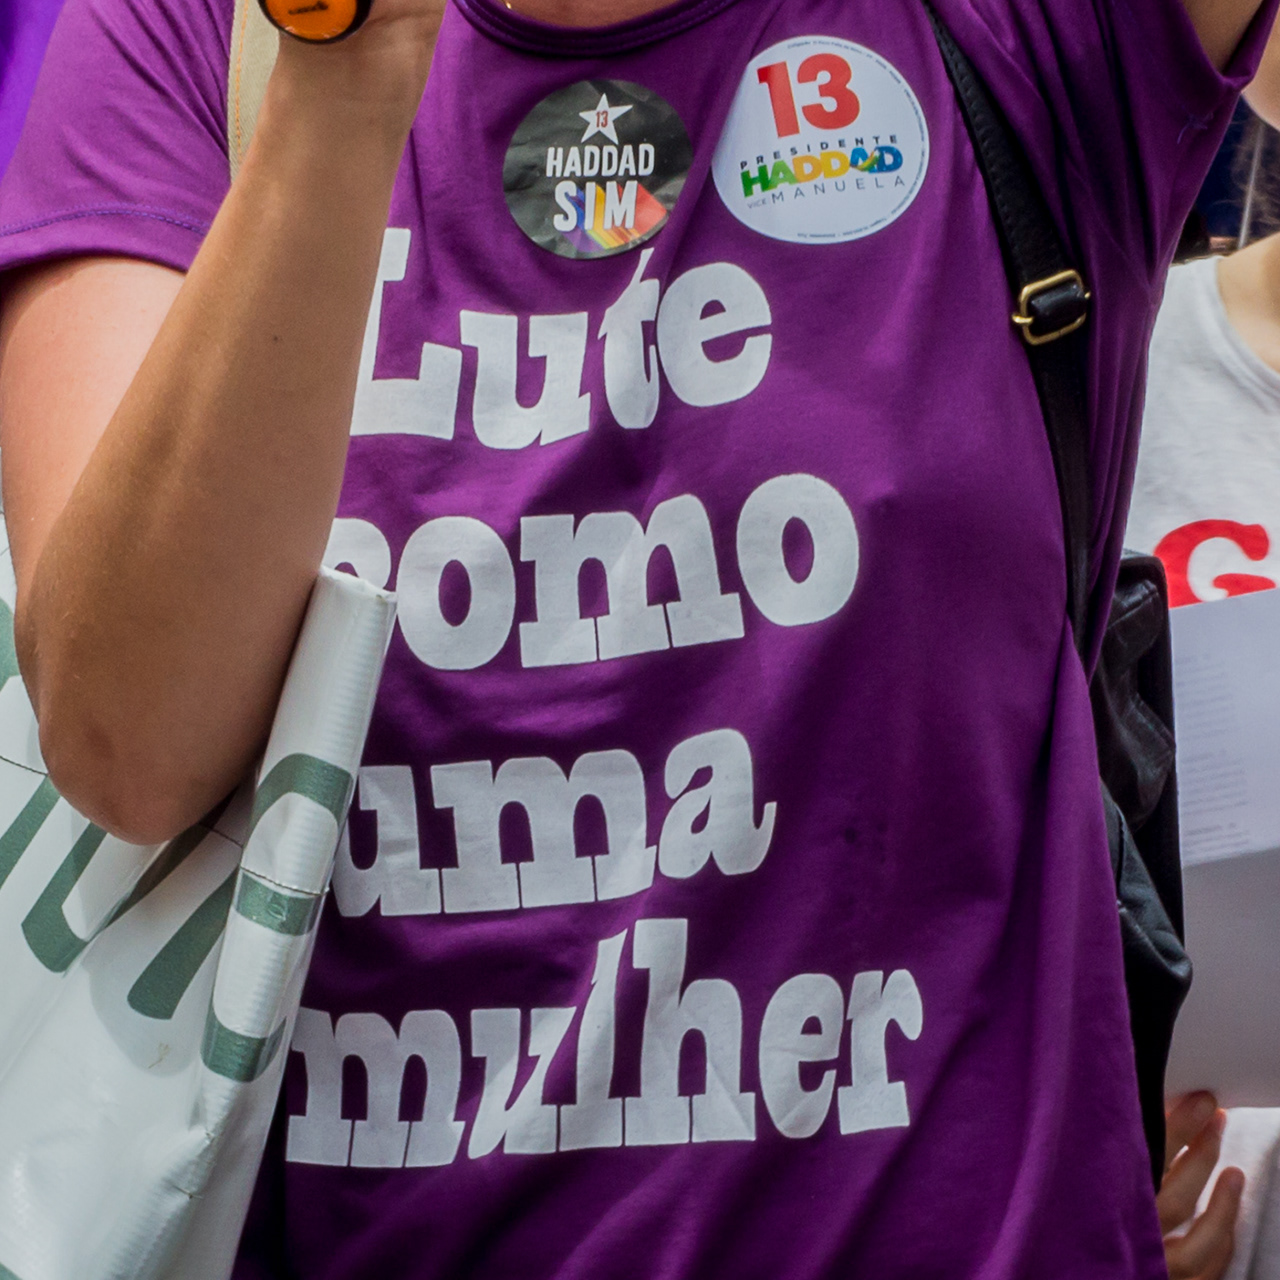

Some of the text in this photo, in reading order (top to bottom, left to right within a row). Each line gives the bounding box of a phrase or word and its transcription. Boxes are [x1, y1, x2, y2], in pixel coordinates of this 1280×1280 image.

[595, 110, 609, 129] 13
[757, 52, 861, 139] 13
[545, 143, 656, 178] HADDAD
[740, 135, 898, 170] PRESIDENTE
[740, 145, 904, 198] HADDAD
[553, 180, 638, 232] SIM
[771, 175, 906, 204] MANUELA
[349, 227, 773, 449] Lute
[332, 728, 777, 917] uma
[285, 917, 924, 1169] mulher
